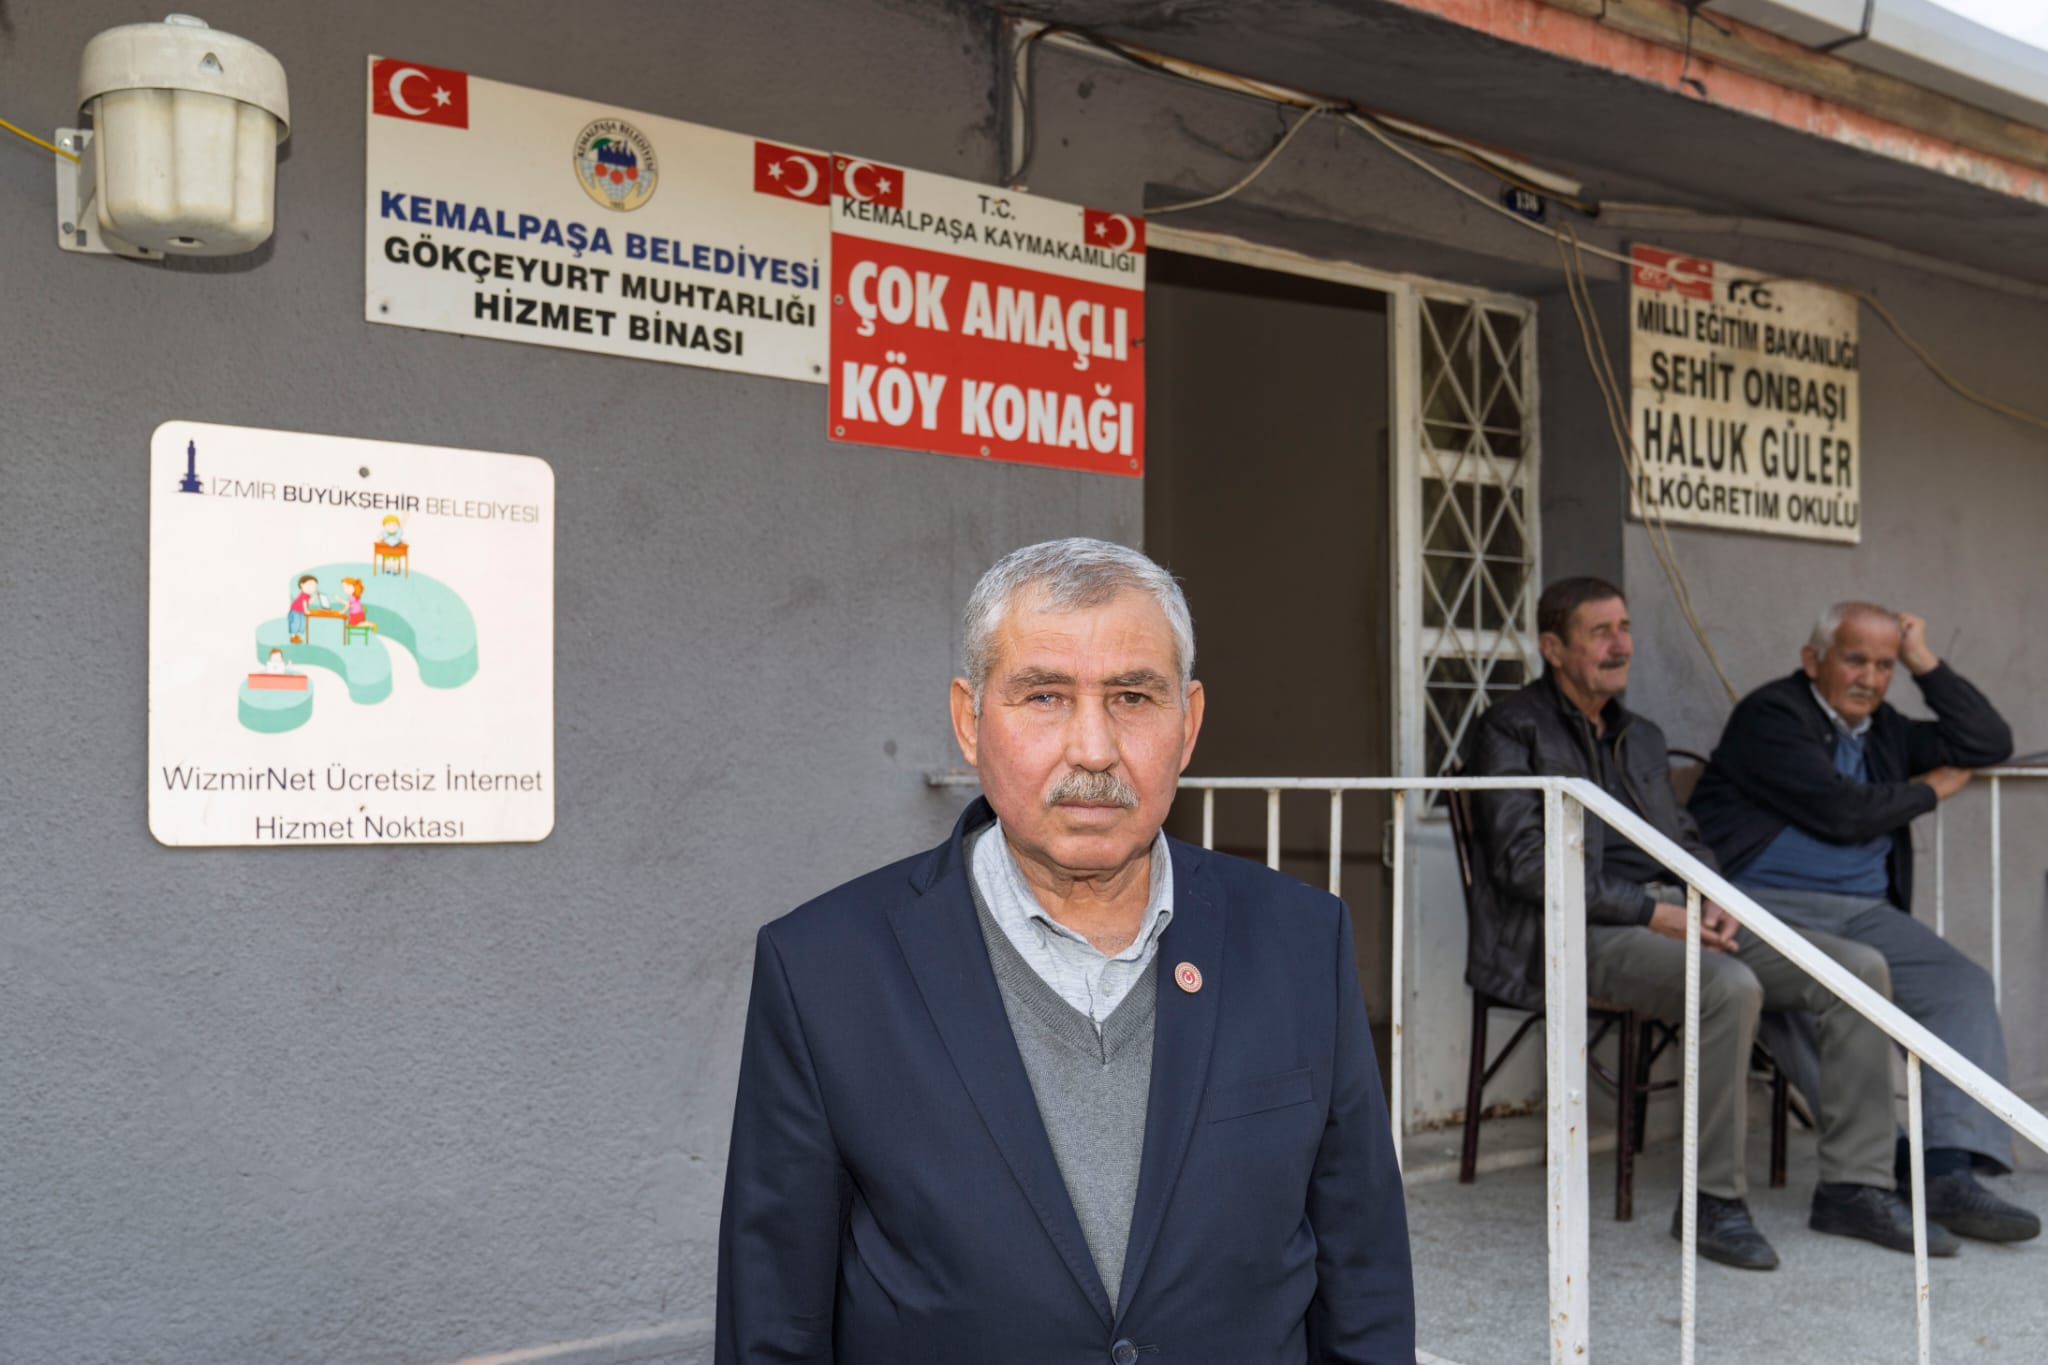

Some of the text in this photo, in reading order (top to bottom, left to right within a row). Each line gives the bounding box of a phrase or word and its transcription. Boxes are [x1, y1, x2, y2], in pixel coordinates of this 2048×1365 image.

[841, 198, 978, 244] KEMALPAŞA
[977, 194, 1017, 221] T.C.
[380, 190, 820, 290] KEMALPAŞA BELEDİYESİ
[384, 233, 817, 328] GÖKÇEYURT MUHTARLIĞI
[474, 291, 744, 356] HİZMET BİNASI
[848, 260, 1128, 371] ÇOK AMAÇLI
[1695, 303, 1759, 351] EĞİTİM
[842, 350, 1134, 456] KÖY KONAĞI
[1651, 350, 1847, 432] ŞEHİT ONBAŞI
[1643, 407, 1853, 489] HALUK GÜLER
[283, 482, 420, 513] BÜYÜKŞEHİR
[426, 497, 540, 524] BELEDİYESİ
[1787, 494, 1860, 528] OKULU
[162, 763, 543, 792] WizmirNet Ücretsiz İnternet
[255, 815, 464, 839] Hizmet Noktası
